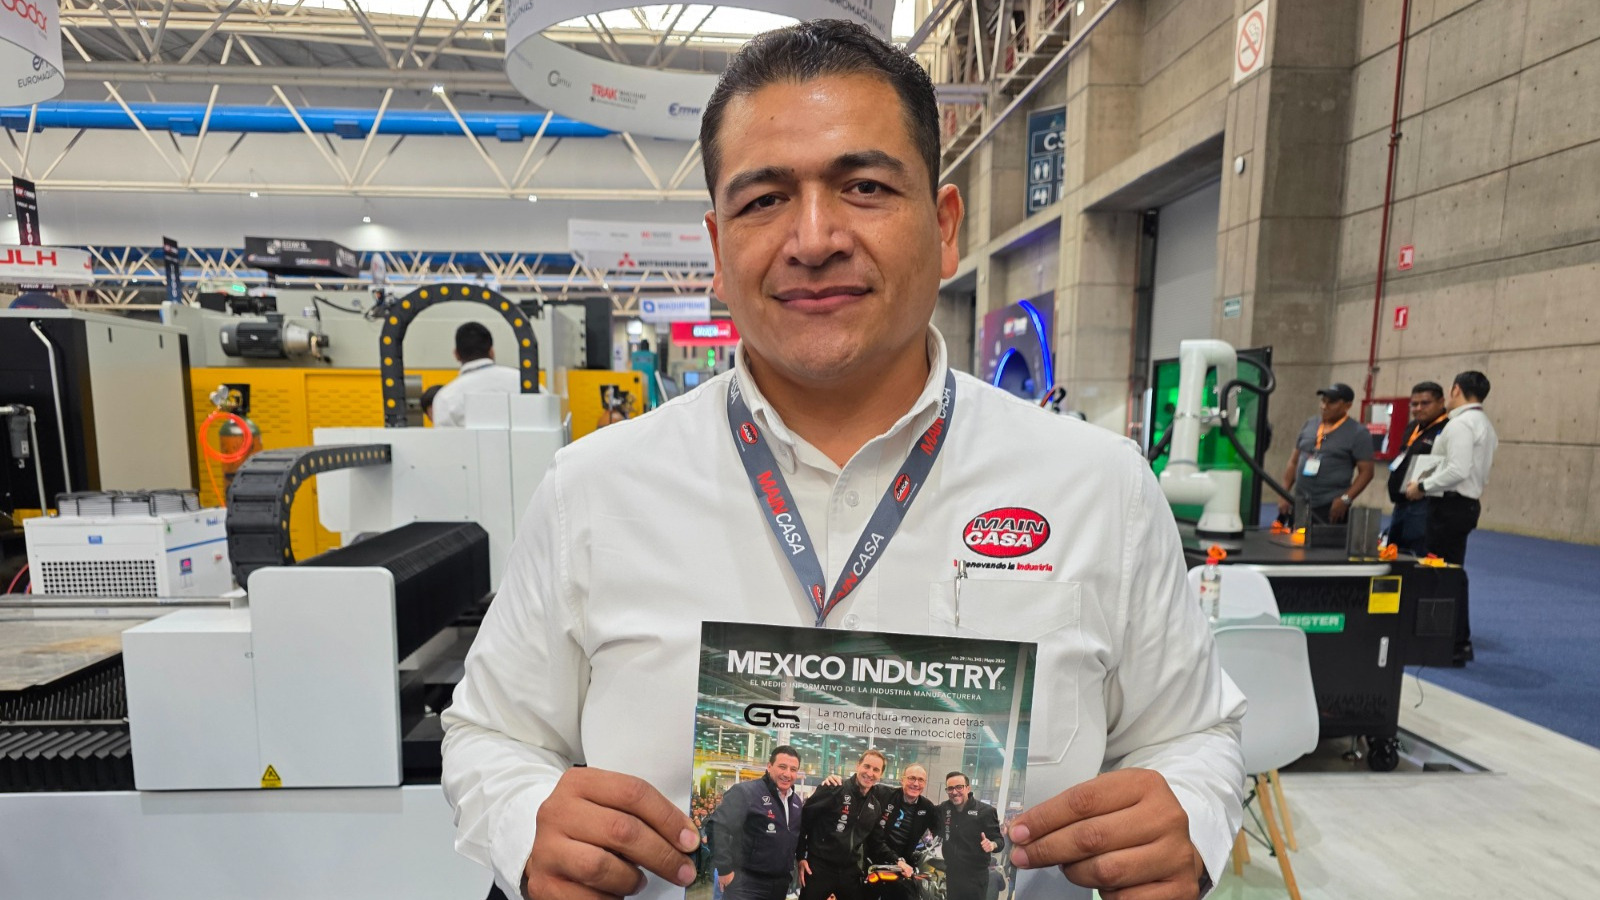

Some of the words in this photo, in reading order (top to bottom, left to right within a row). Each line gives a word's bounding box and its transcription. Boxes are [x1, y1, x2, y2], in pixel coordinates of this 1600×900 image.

[972, 517, 1045, 534] MAIN
[965, 531, 1033, 548] CASA
[965, 561, 1007, 570] enovando
[1017, 562, 1053, 572] Industria
[727, 649, 847, 680] MEXICO
[852, 657, 1006, 691] INDUSTRY
[761, 680, 787, 688] MEDIO
[789, 682, 843, 692] INFORMATIVO
[858, 686, 868, 694] LA
[870, 687, 911, 696] INDUSTRIA
[913, 690, 982, 701] MANUFACTURERA
[772, 721, 800, 729] MOTOS
[818, 708, 830, 717] La
[832, 709, 898, 722] manufactura
[901, 713, 950, 725] mexicana
[952, 716, 985, 727] detrás
[816, 722, 830, 731] de
[833, 723, 845, 731] 10
[848, 723, 892, 735] millones
[894, 727, 908, 736] de
[910, 729, 977, 740] motocicletas
